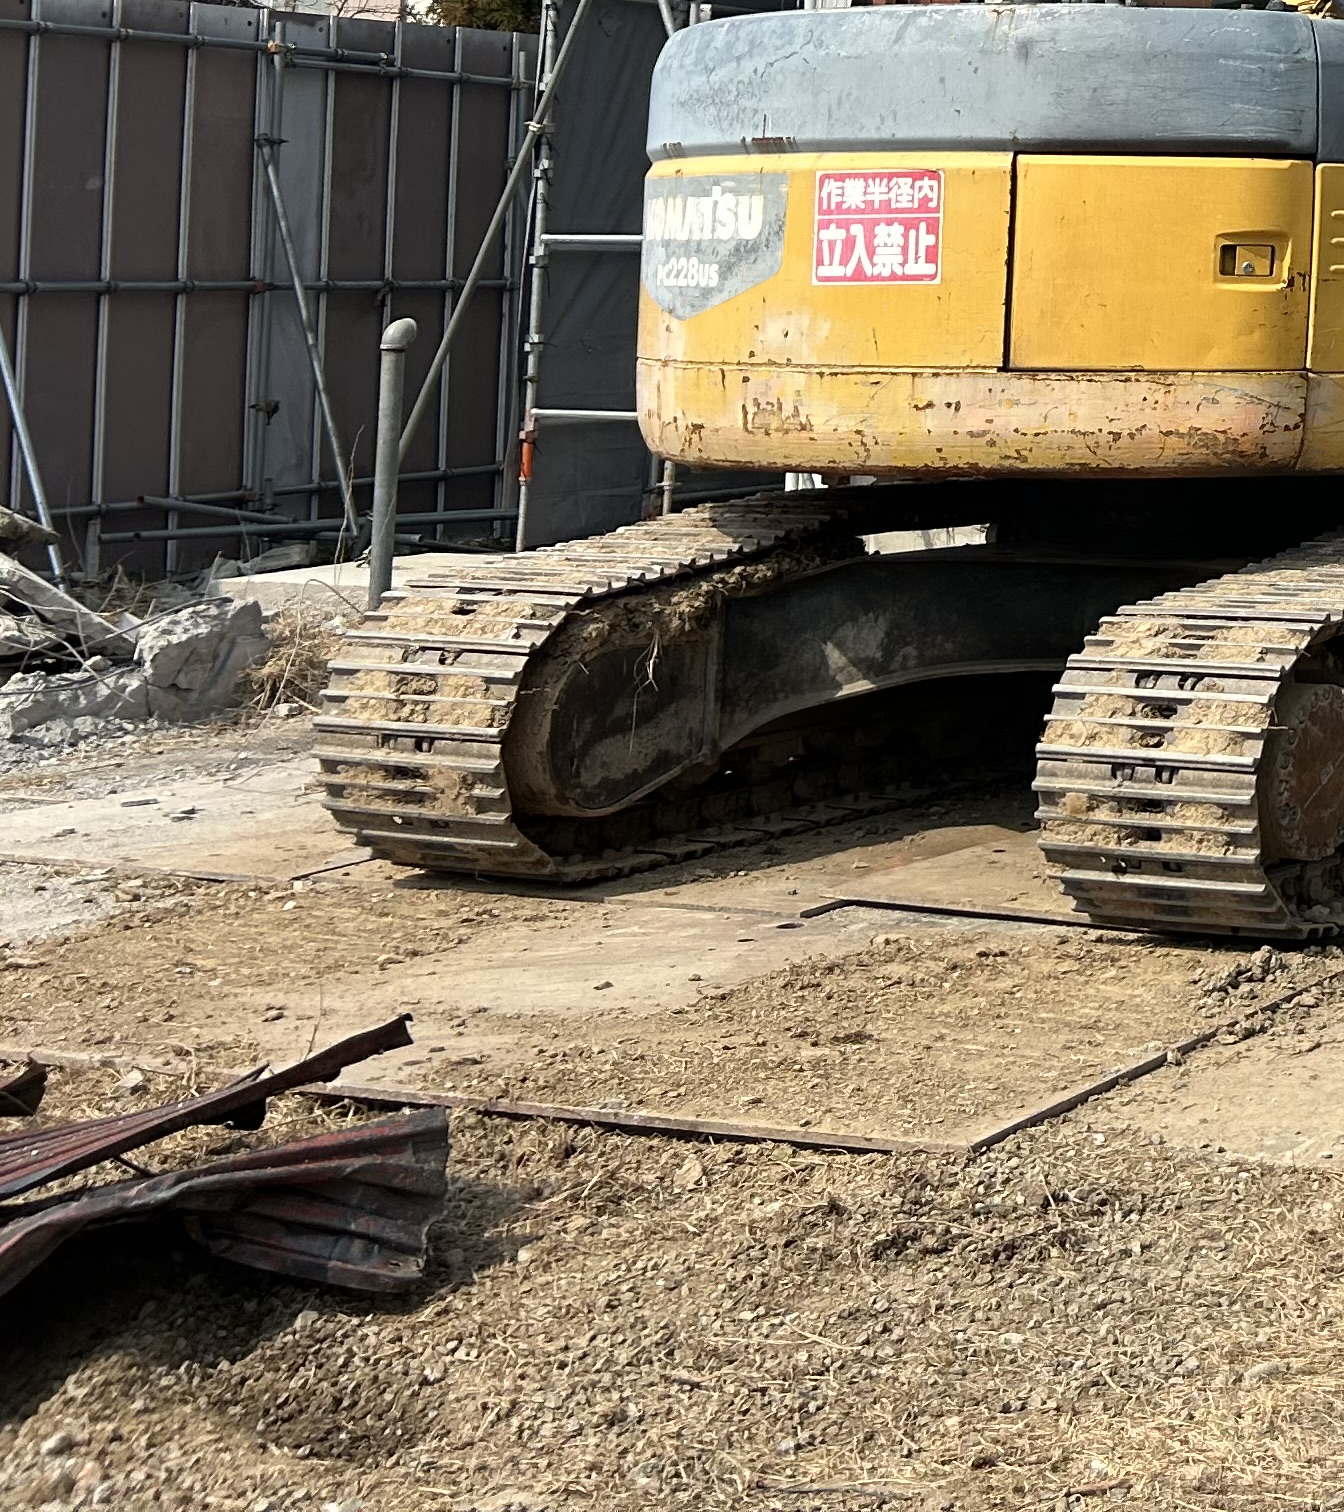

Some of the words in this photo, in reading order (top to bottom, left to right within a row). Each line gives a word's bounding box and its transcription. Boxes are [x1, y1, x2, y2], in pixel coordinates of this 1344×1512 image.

[820, 176, 938, 211] 作業半径内
[816, 221, 937, 278] 立入禁止
[656, 256, 719, 288] PC228US
